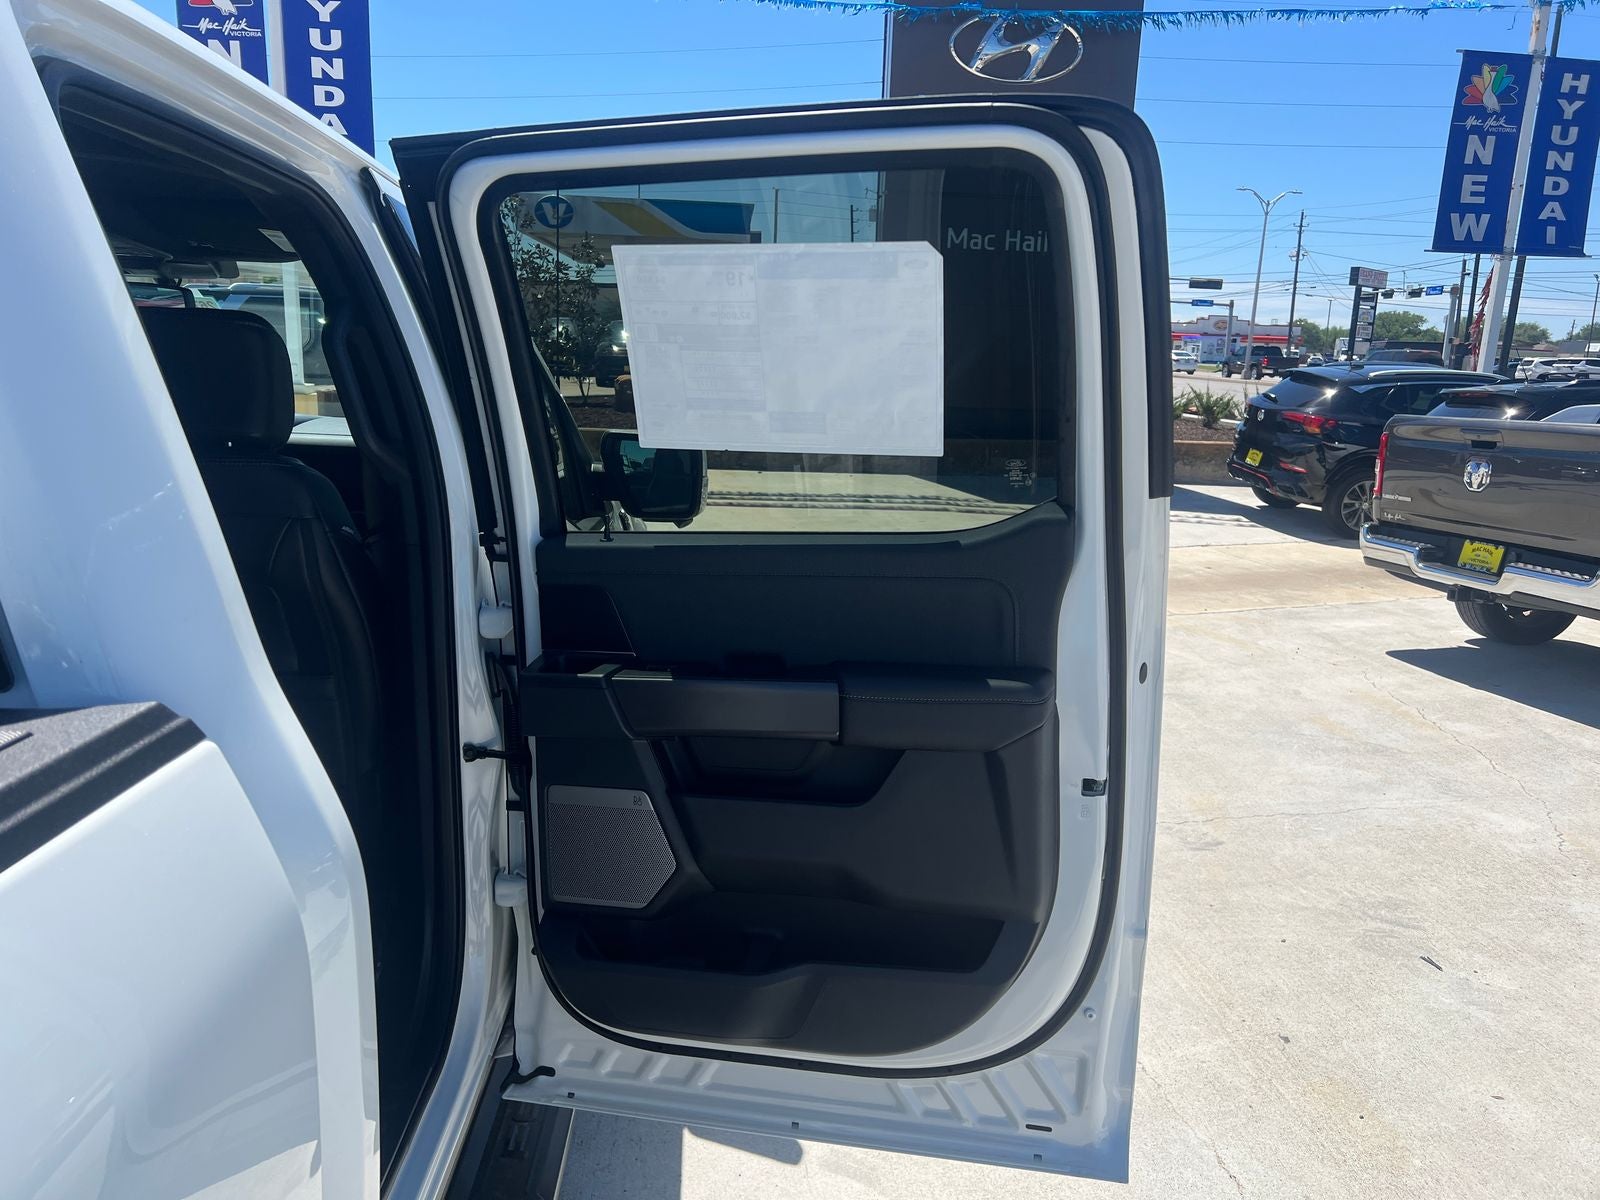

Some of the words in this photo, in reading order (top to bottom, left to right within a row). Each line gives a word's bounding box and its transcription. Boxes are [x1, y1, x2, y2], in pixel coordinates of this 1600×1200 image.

[188, 17, 222, 34] Mac
[222, 17, 256, 35] Haik
[306, 0, 348, 135] YUNDA
[1457, 115, 1484, 130] Mac
[1483, 114, 1512, 131] Haik
[1450, 135, 1496, 242] NEW
[1538, 73, 1590, 245] HYUNDAI
[947, 227, 996, 251] Mac
